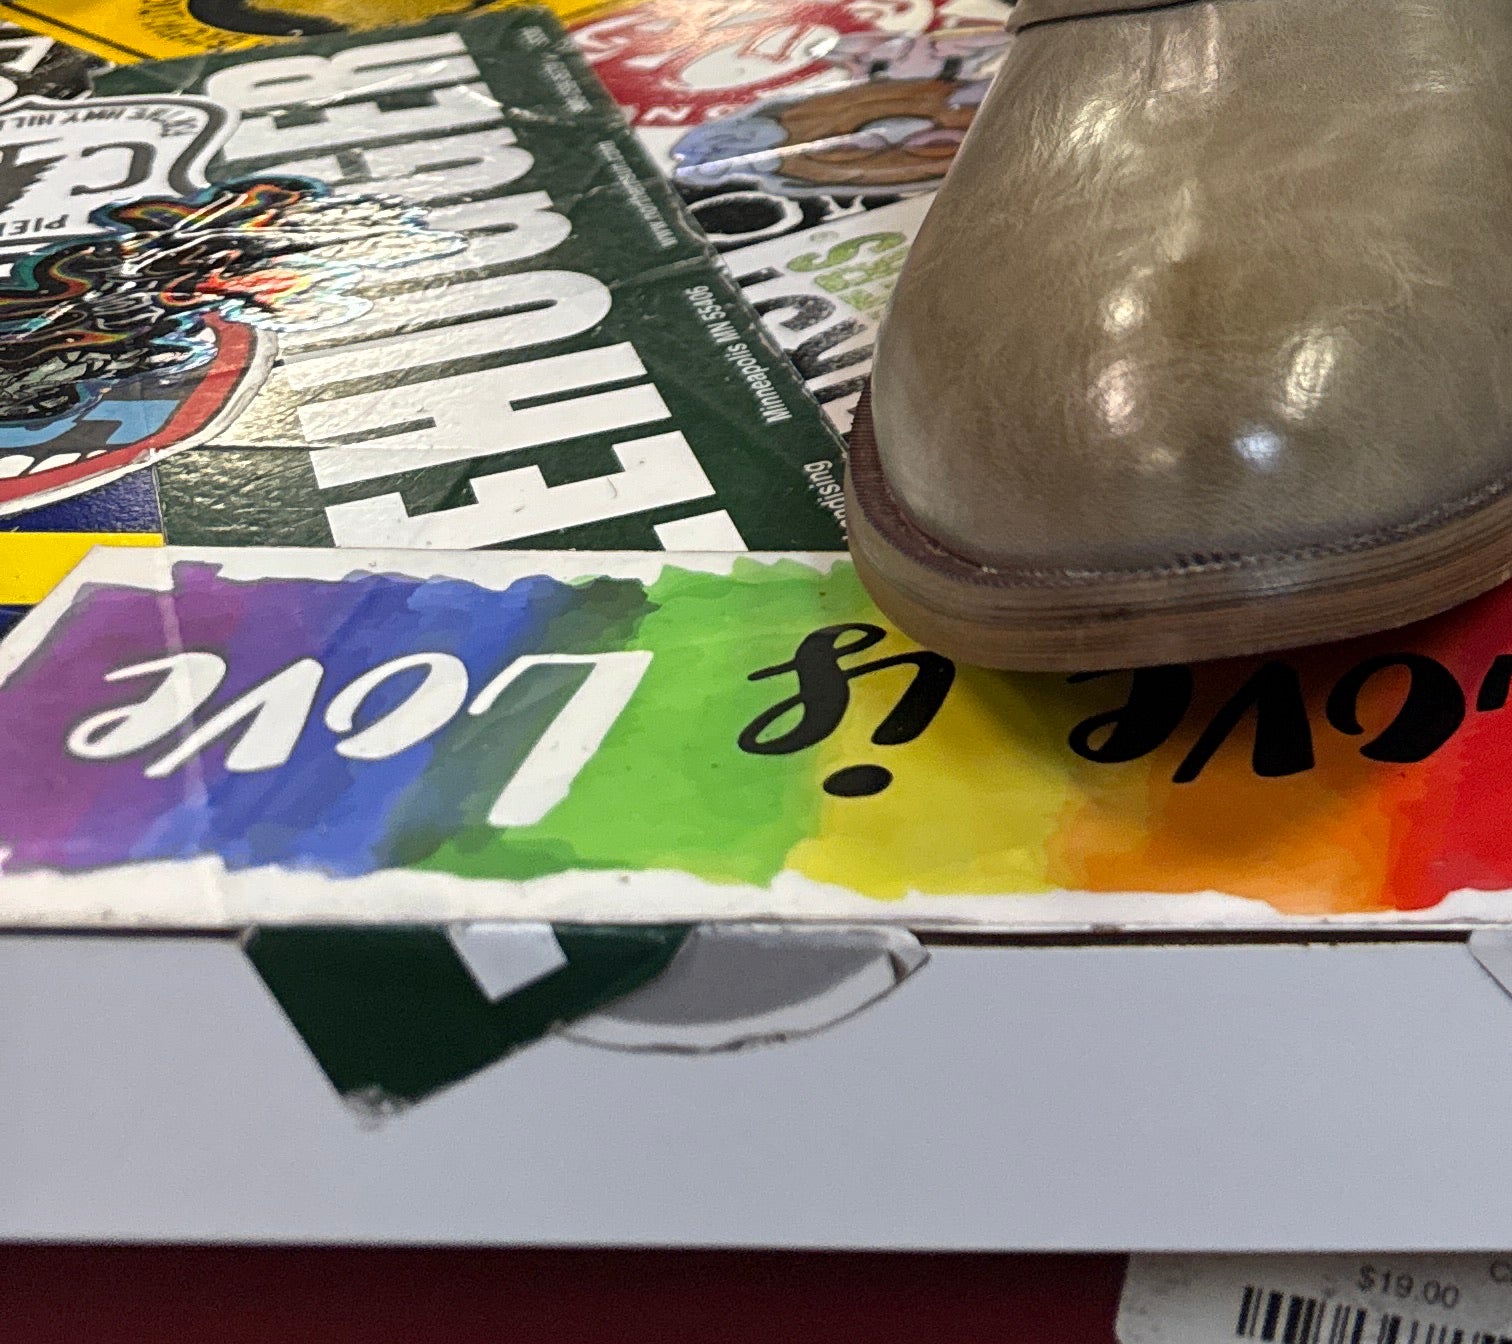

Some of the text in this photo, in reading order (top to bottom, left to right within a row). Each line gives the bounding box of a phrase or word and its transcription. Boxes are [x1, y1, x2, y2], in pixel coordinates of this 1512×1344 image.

[684, 285, 793, 424] Minneapolis MN 55406
[66, 649, 653, 828] Love
[736, 623, 956, 798] is
[1355, 1263, 1460, 1310] $19.00
